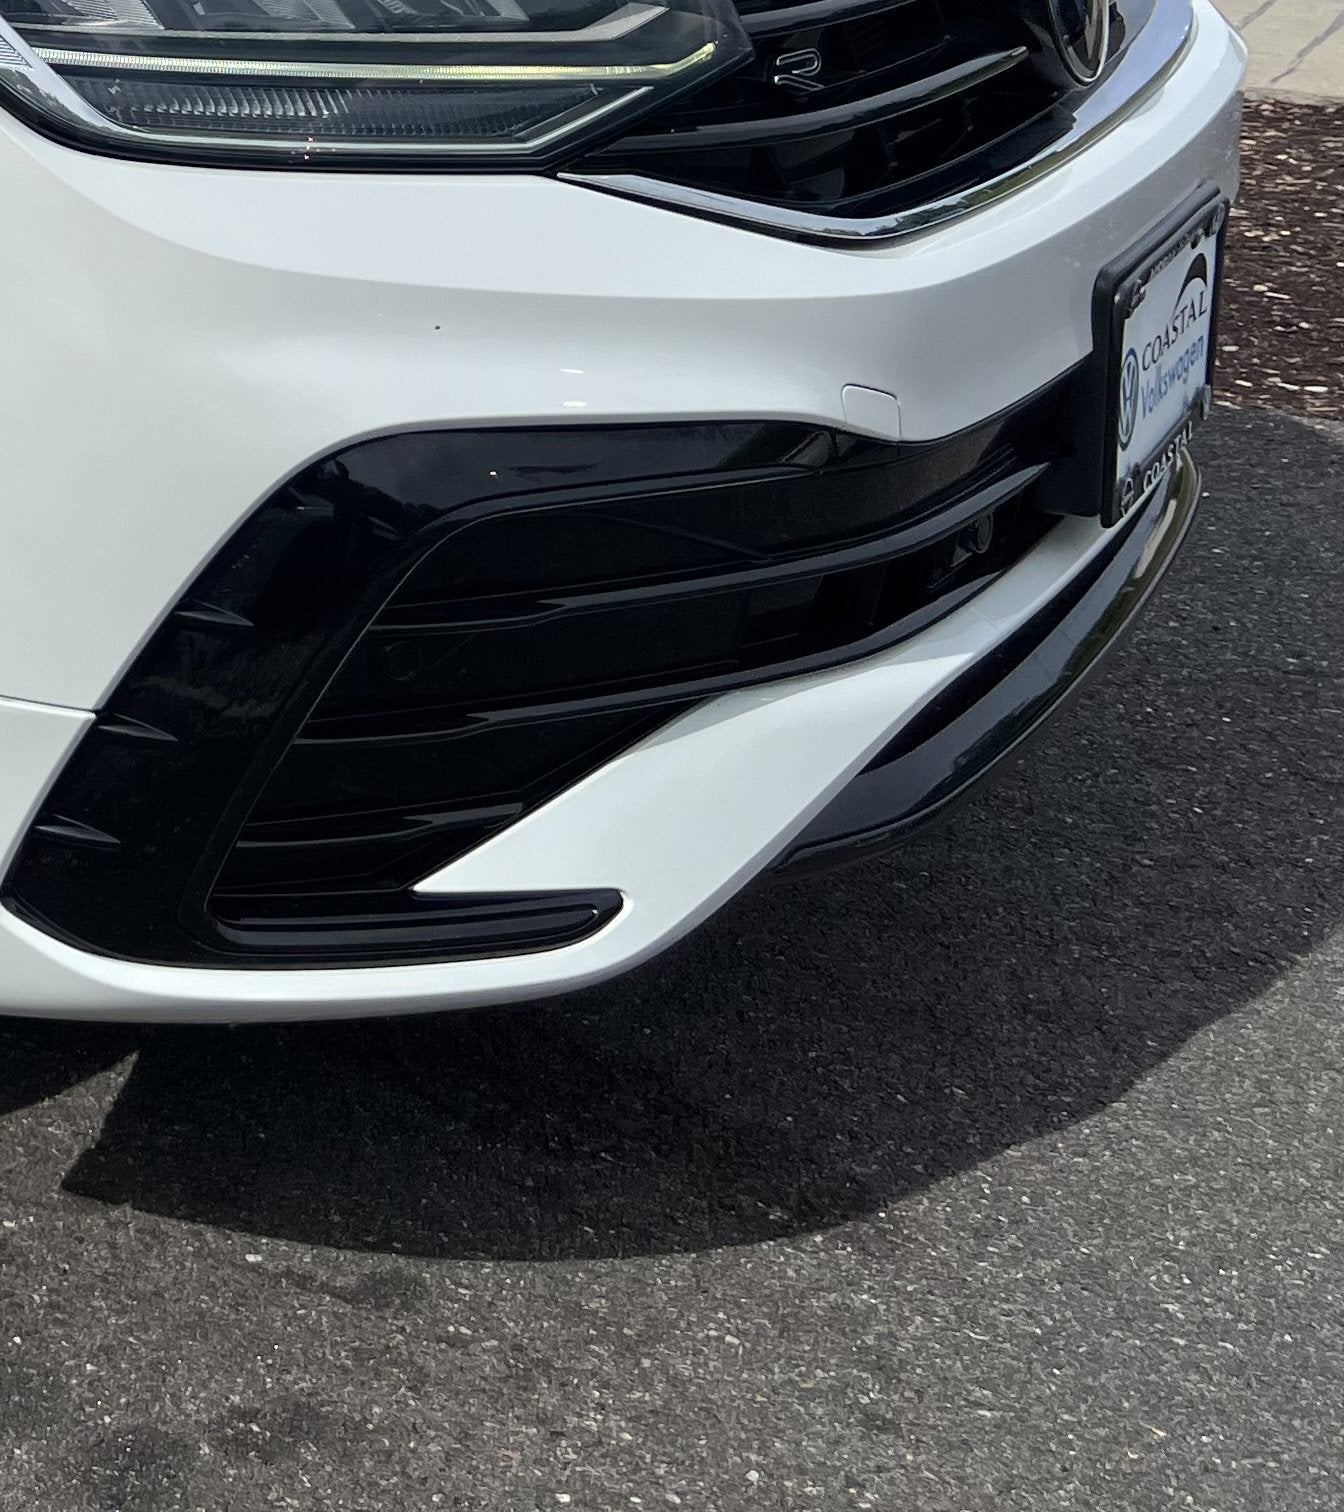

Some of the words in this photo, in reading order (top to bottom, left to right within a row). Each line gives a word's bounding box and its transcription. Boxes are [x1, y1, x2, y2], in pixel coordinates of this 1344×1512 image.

[774, 48, 825, 92] R
[1142, 291, 1207, 371] COASTAL
[1141, 336, 1204, 419] Volkswagen
